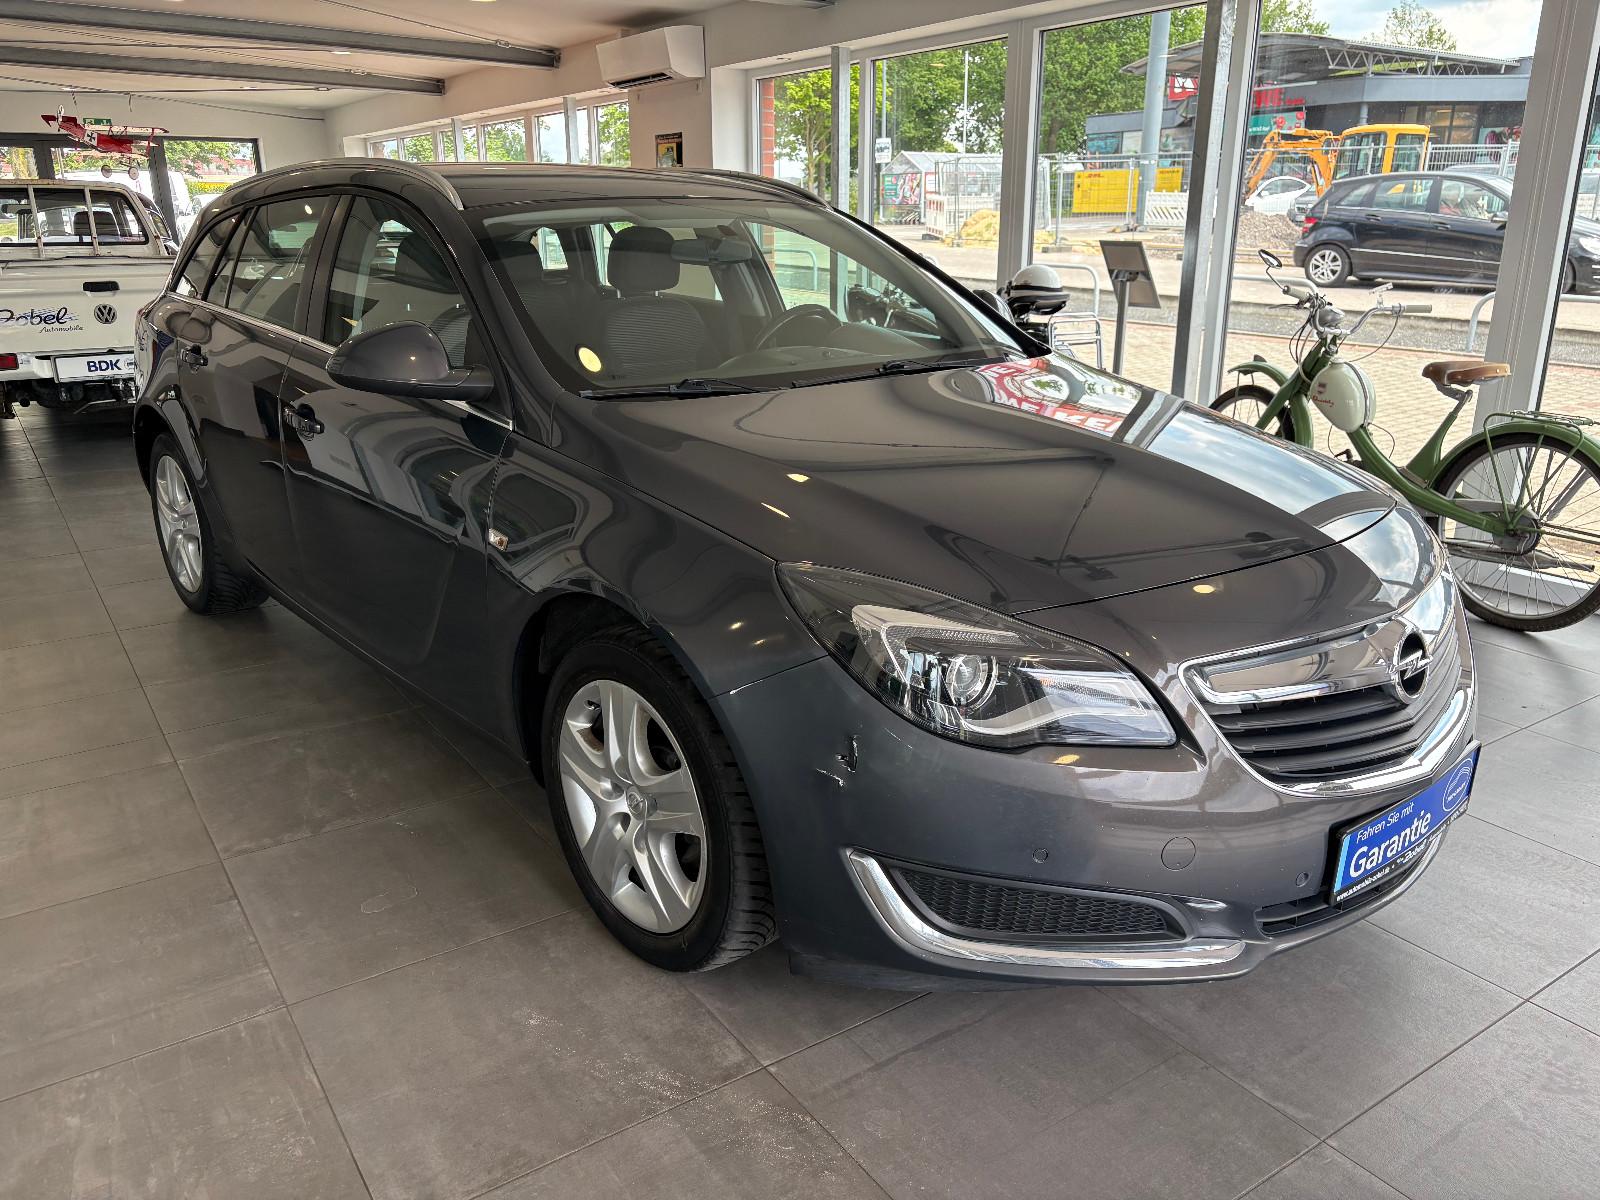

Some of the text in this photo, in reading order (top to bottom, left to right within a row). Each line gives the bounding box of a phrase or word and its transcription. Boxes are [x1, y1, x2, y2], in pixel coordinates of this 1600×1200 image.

[1253, 88, 1284, 108] WE
[87, 359, 122, 373] BDK
[1357, 802, 1415, 844] Fahren Sie mit
[1349, 810, 1431, 878] Garantie
